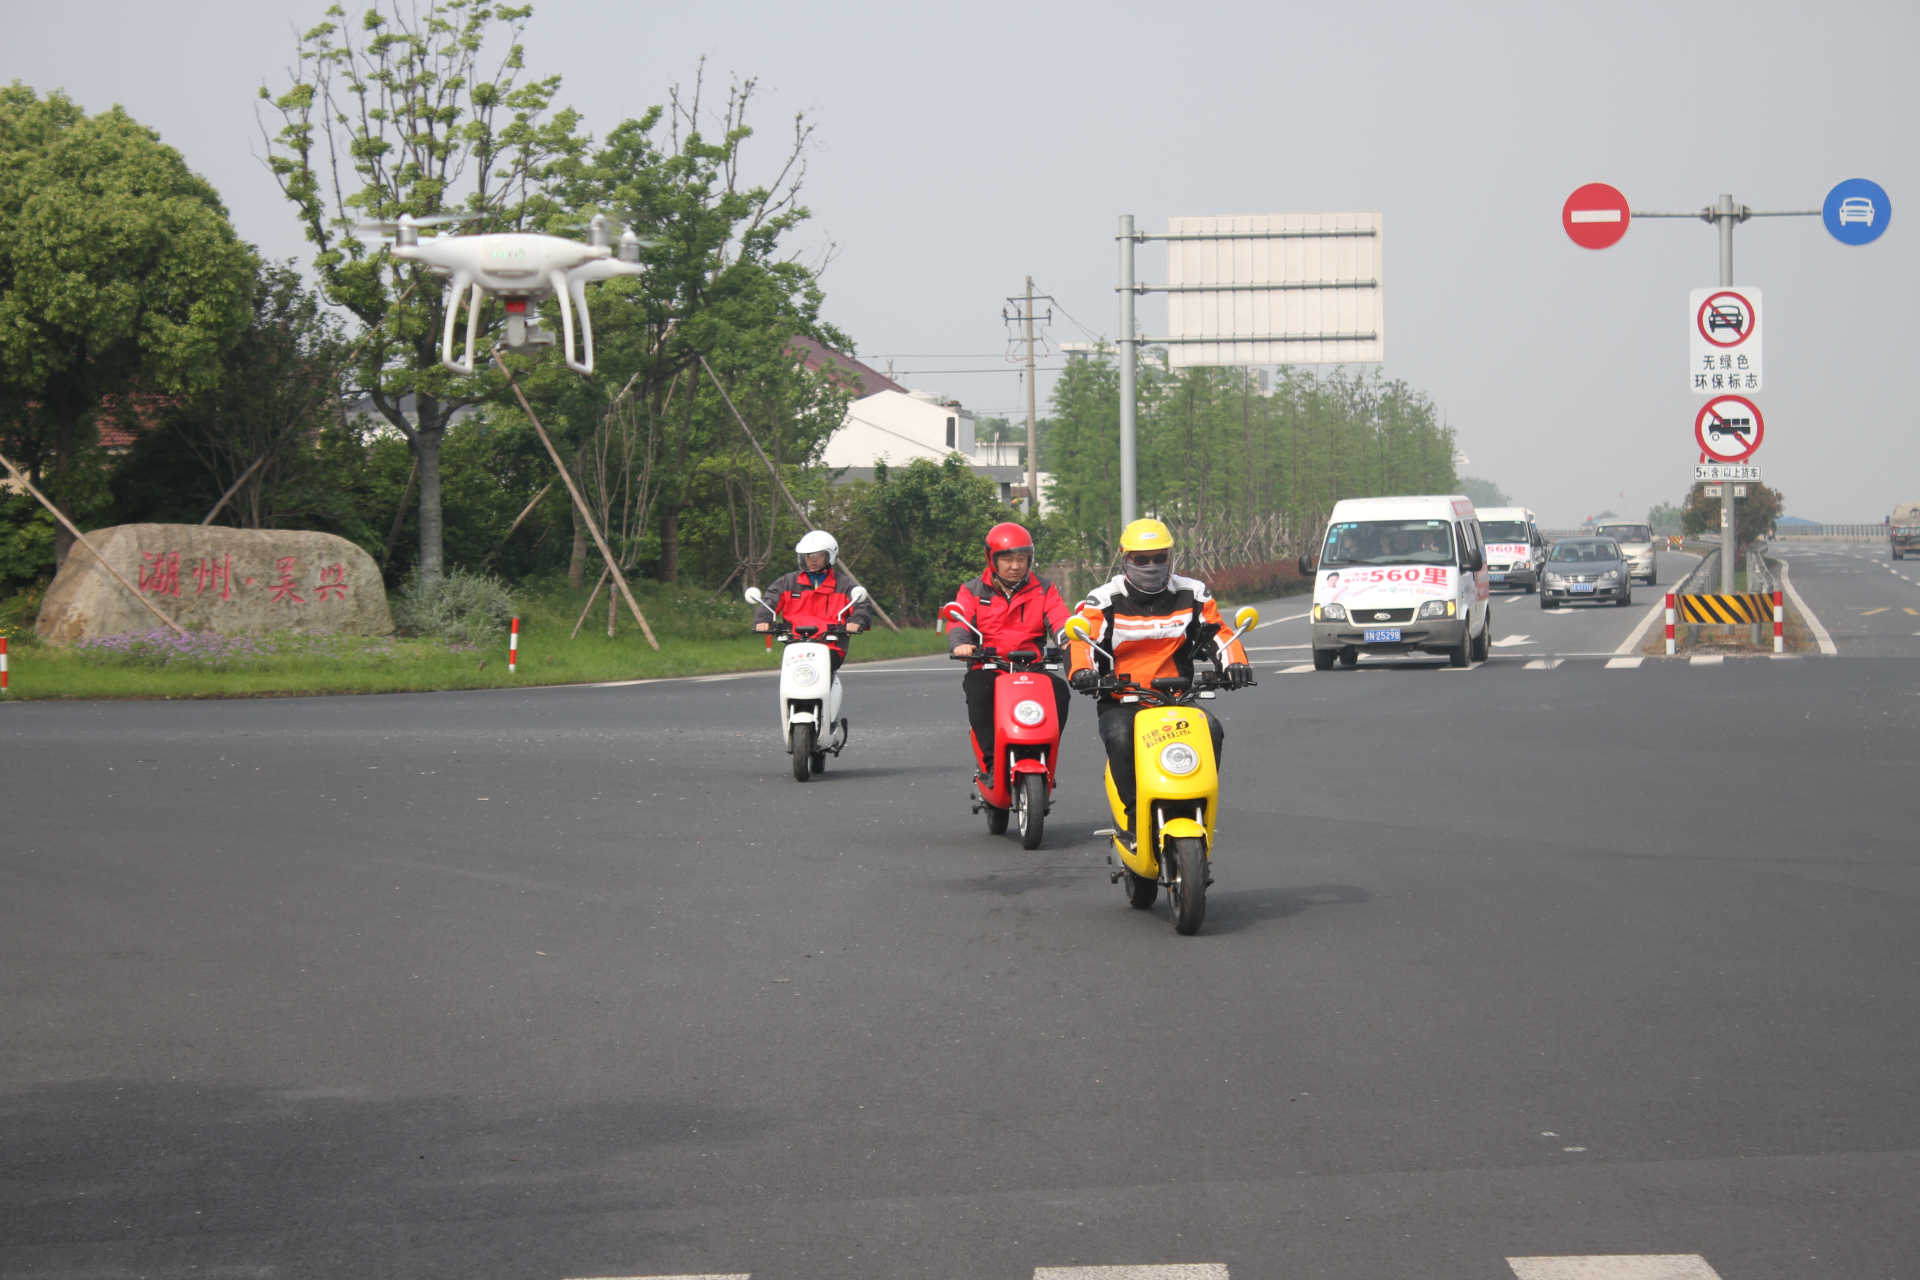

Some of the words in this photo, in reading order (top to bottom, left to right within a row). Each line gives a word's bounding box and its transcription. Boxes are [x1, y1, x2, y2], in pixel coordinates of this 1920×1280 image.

[1703, 354, 1750, 370] 无绿色
[1695, 373, 1758, 390] 环保标志
